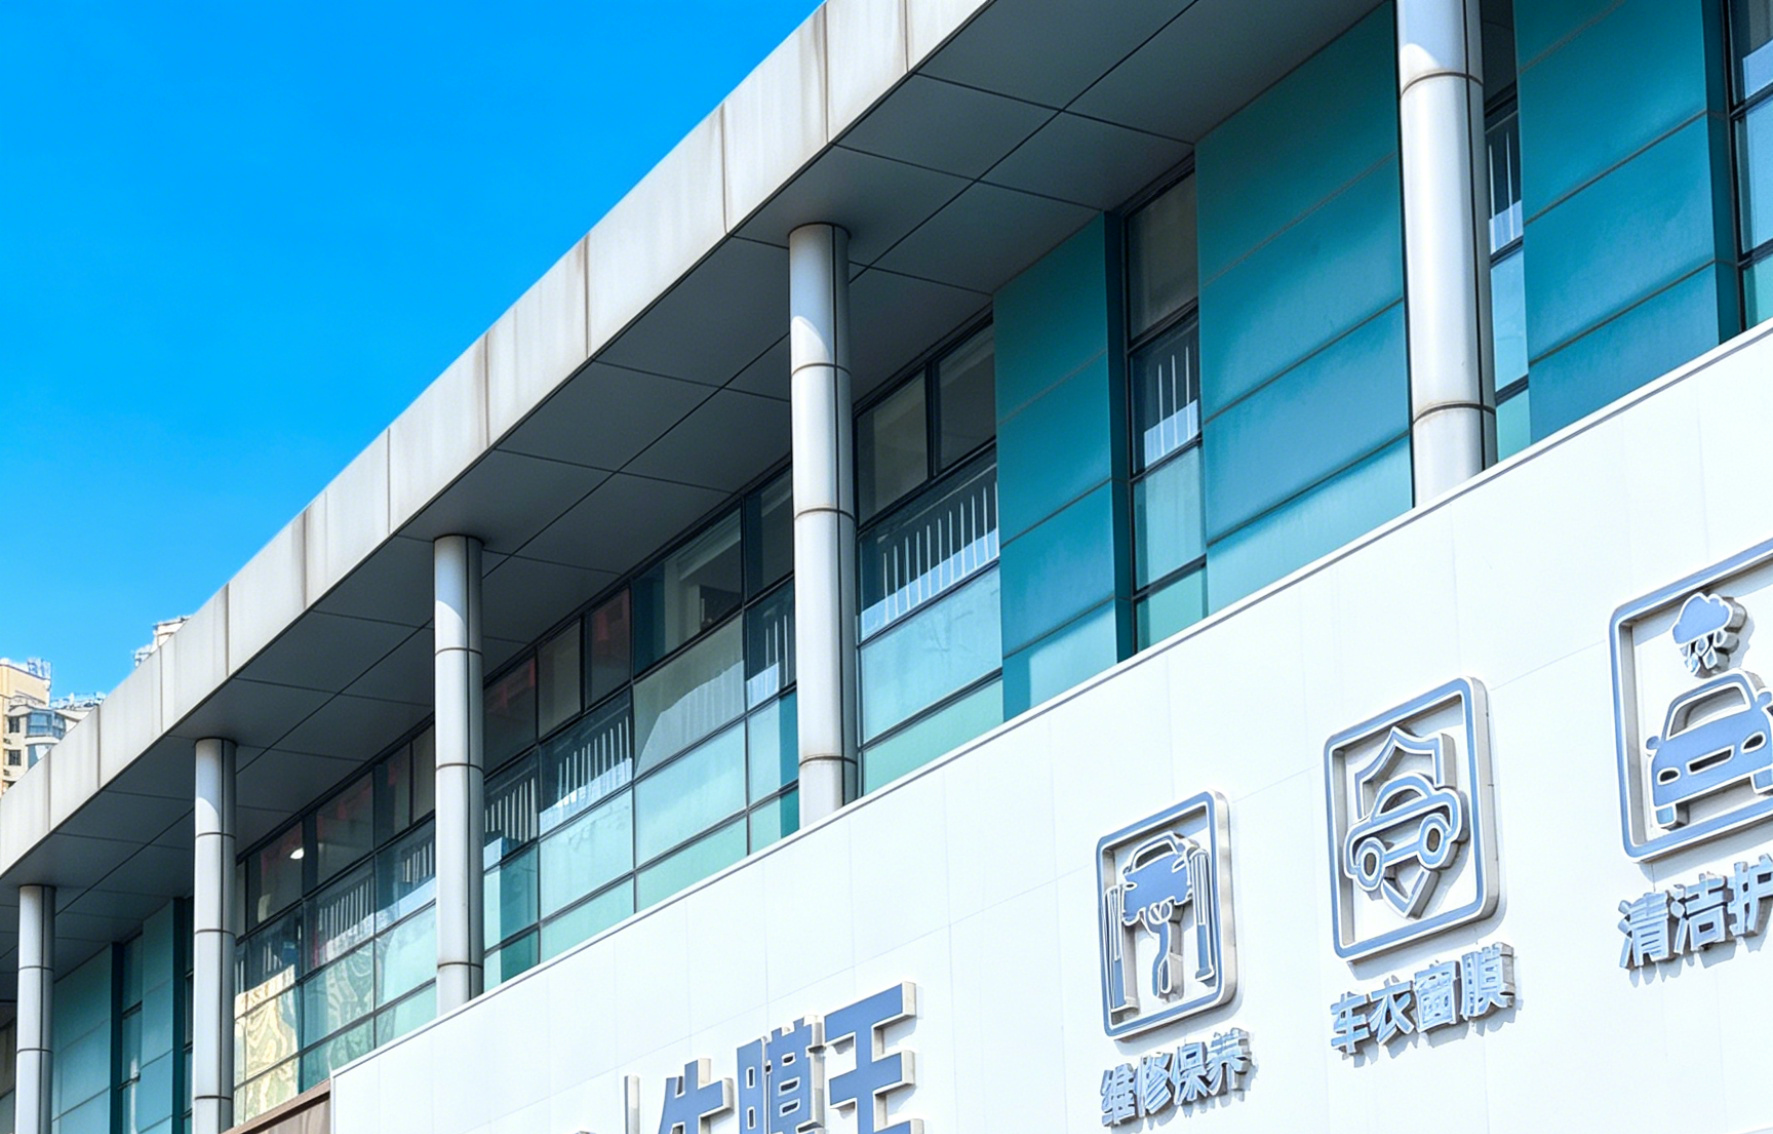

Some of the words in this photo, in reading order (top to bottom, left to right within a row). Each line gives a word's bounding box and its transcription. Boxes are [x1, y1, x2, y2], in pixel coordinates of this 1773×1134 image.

[1618, 853, 1773, 971] 清洁护
[1100, 1028, 1252, 1127] 维修保养
